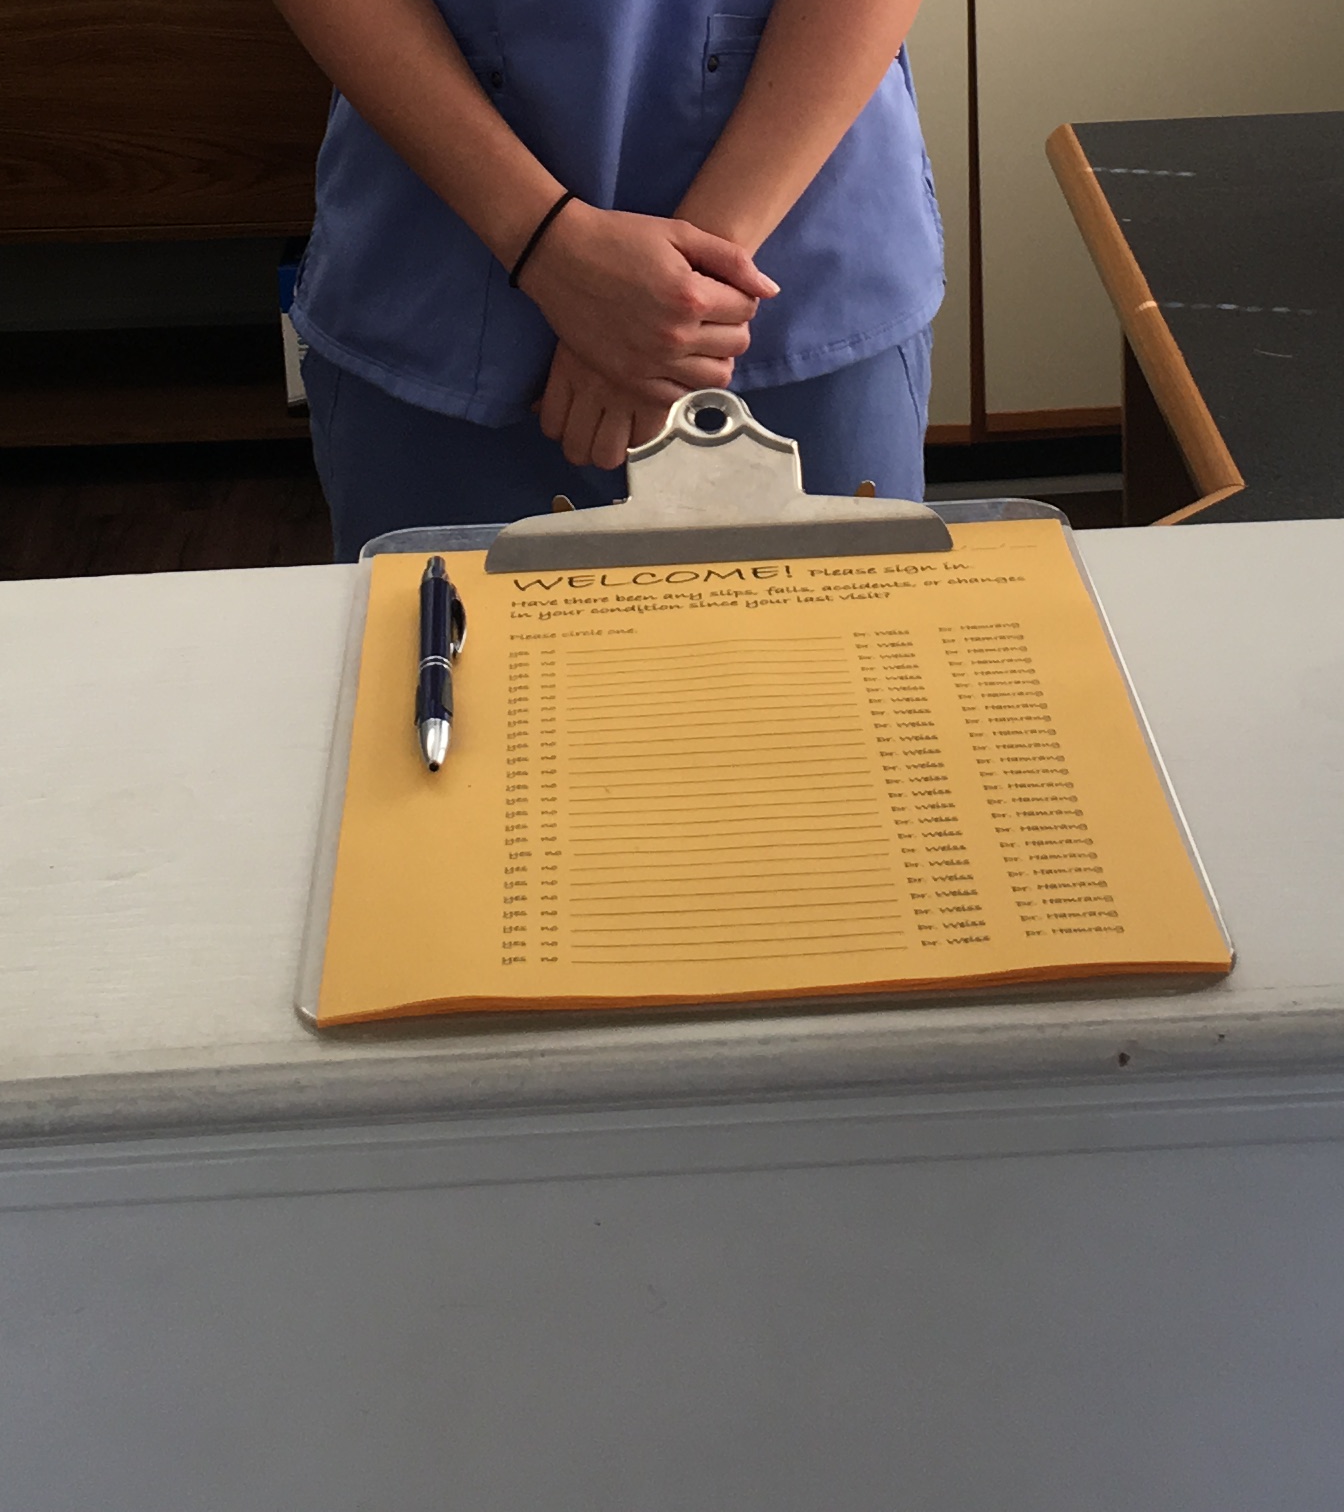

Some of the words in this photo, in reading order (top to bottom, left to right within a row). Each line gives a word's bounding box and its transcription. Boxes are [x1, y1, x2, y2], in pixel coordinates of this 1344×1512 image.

[511, 599, 558, 607] Have
[563, 595, 609, 605] there
[615, 591, 657, 602] been
[662, 589, 703, 601] any
[709, 587, 759, 598] slips,
[766, 584, 815, 596] falls,
[821, 579, 917, 592] accidents,
[923, 577, 942, 587] or
[947, 573, 1027, 585] changes
[513, 565, 792, 591] WELCOME!
[883, 563, 937, 576] sign
[510, 610, 533, 619] in
[537, 607, 584, 621] your
[590, 601, 684, 614] condition
[688, 597, 739, 608] since
[745, 595, 791, 609] your
[796, 595, 833, 604] last
[839, 590, 891, 601] visit?
[561, 628, 603, 638] circle
